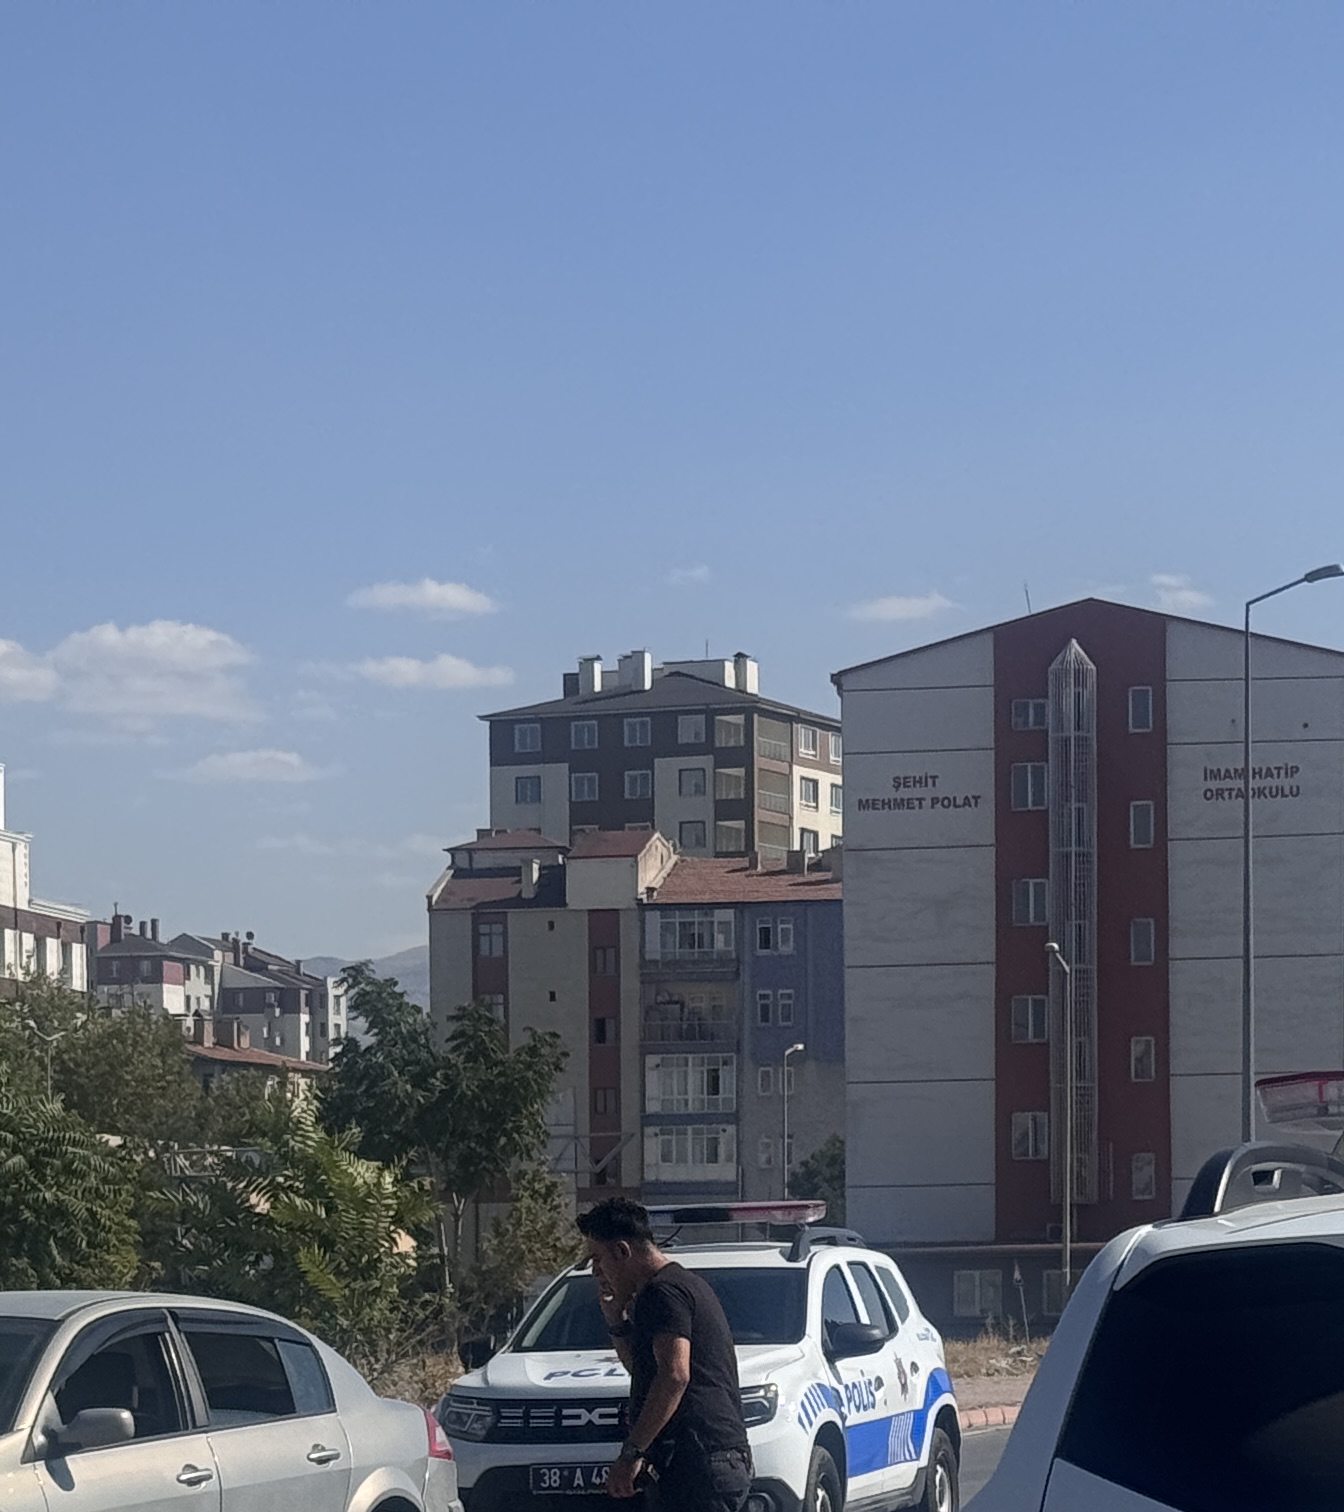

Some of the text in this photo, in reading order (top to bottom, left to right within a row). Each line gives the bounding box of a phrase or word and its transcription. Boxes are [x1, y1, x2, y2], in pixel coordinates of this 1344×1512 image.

[892, 772, 939, 793] ŞEHİT
[1203, 763, 1300, 782] İMAM HATİP
[857, 795, 981, 812] MEHMET POLAT
[543, 1367, 630, 1382] POL
[843, 1368, 877, 1416] POLİS
[539, 1468, 561, 1488] 38
[573, 1467, 585, 1488] A
